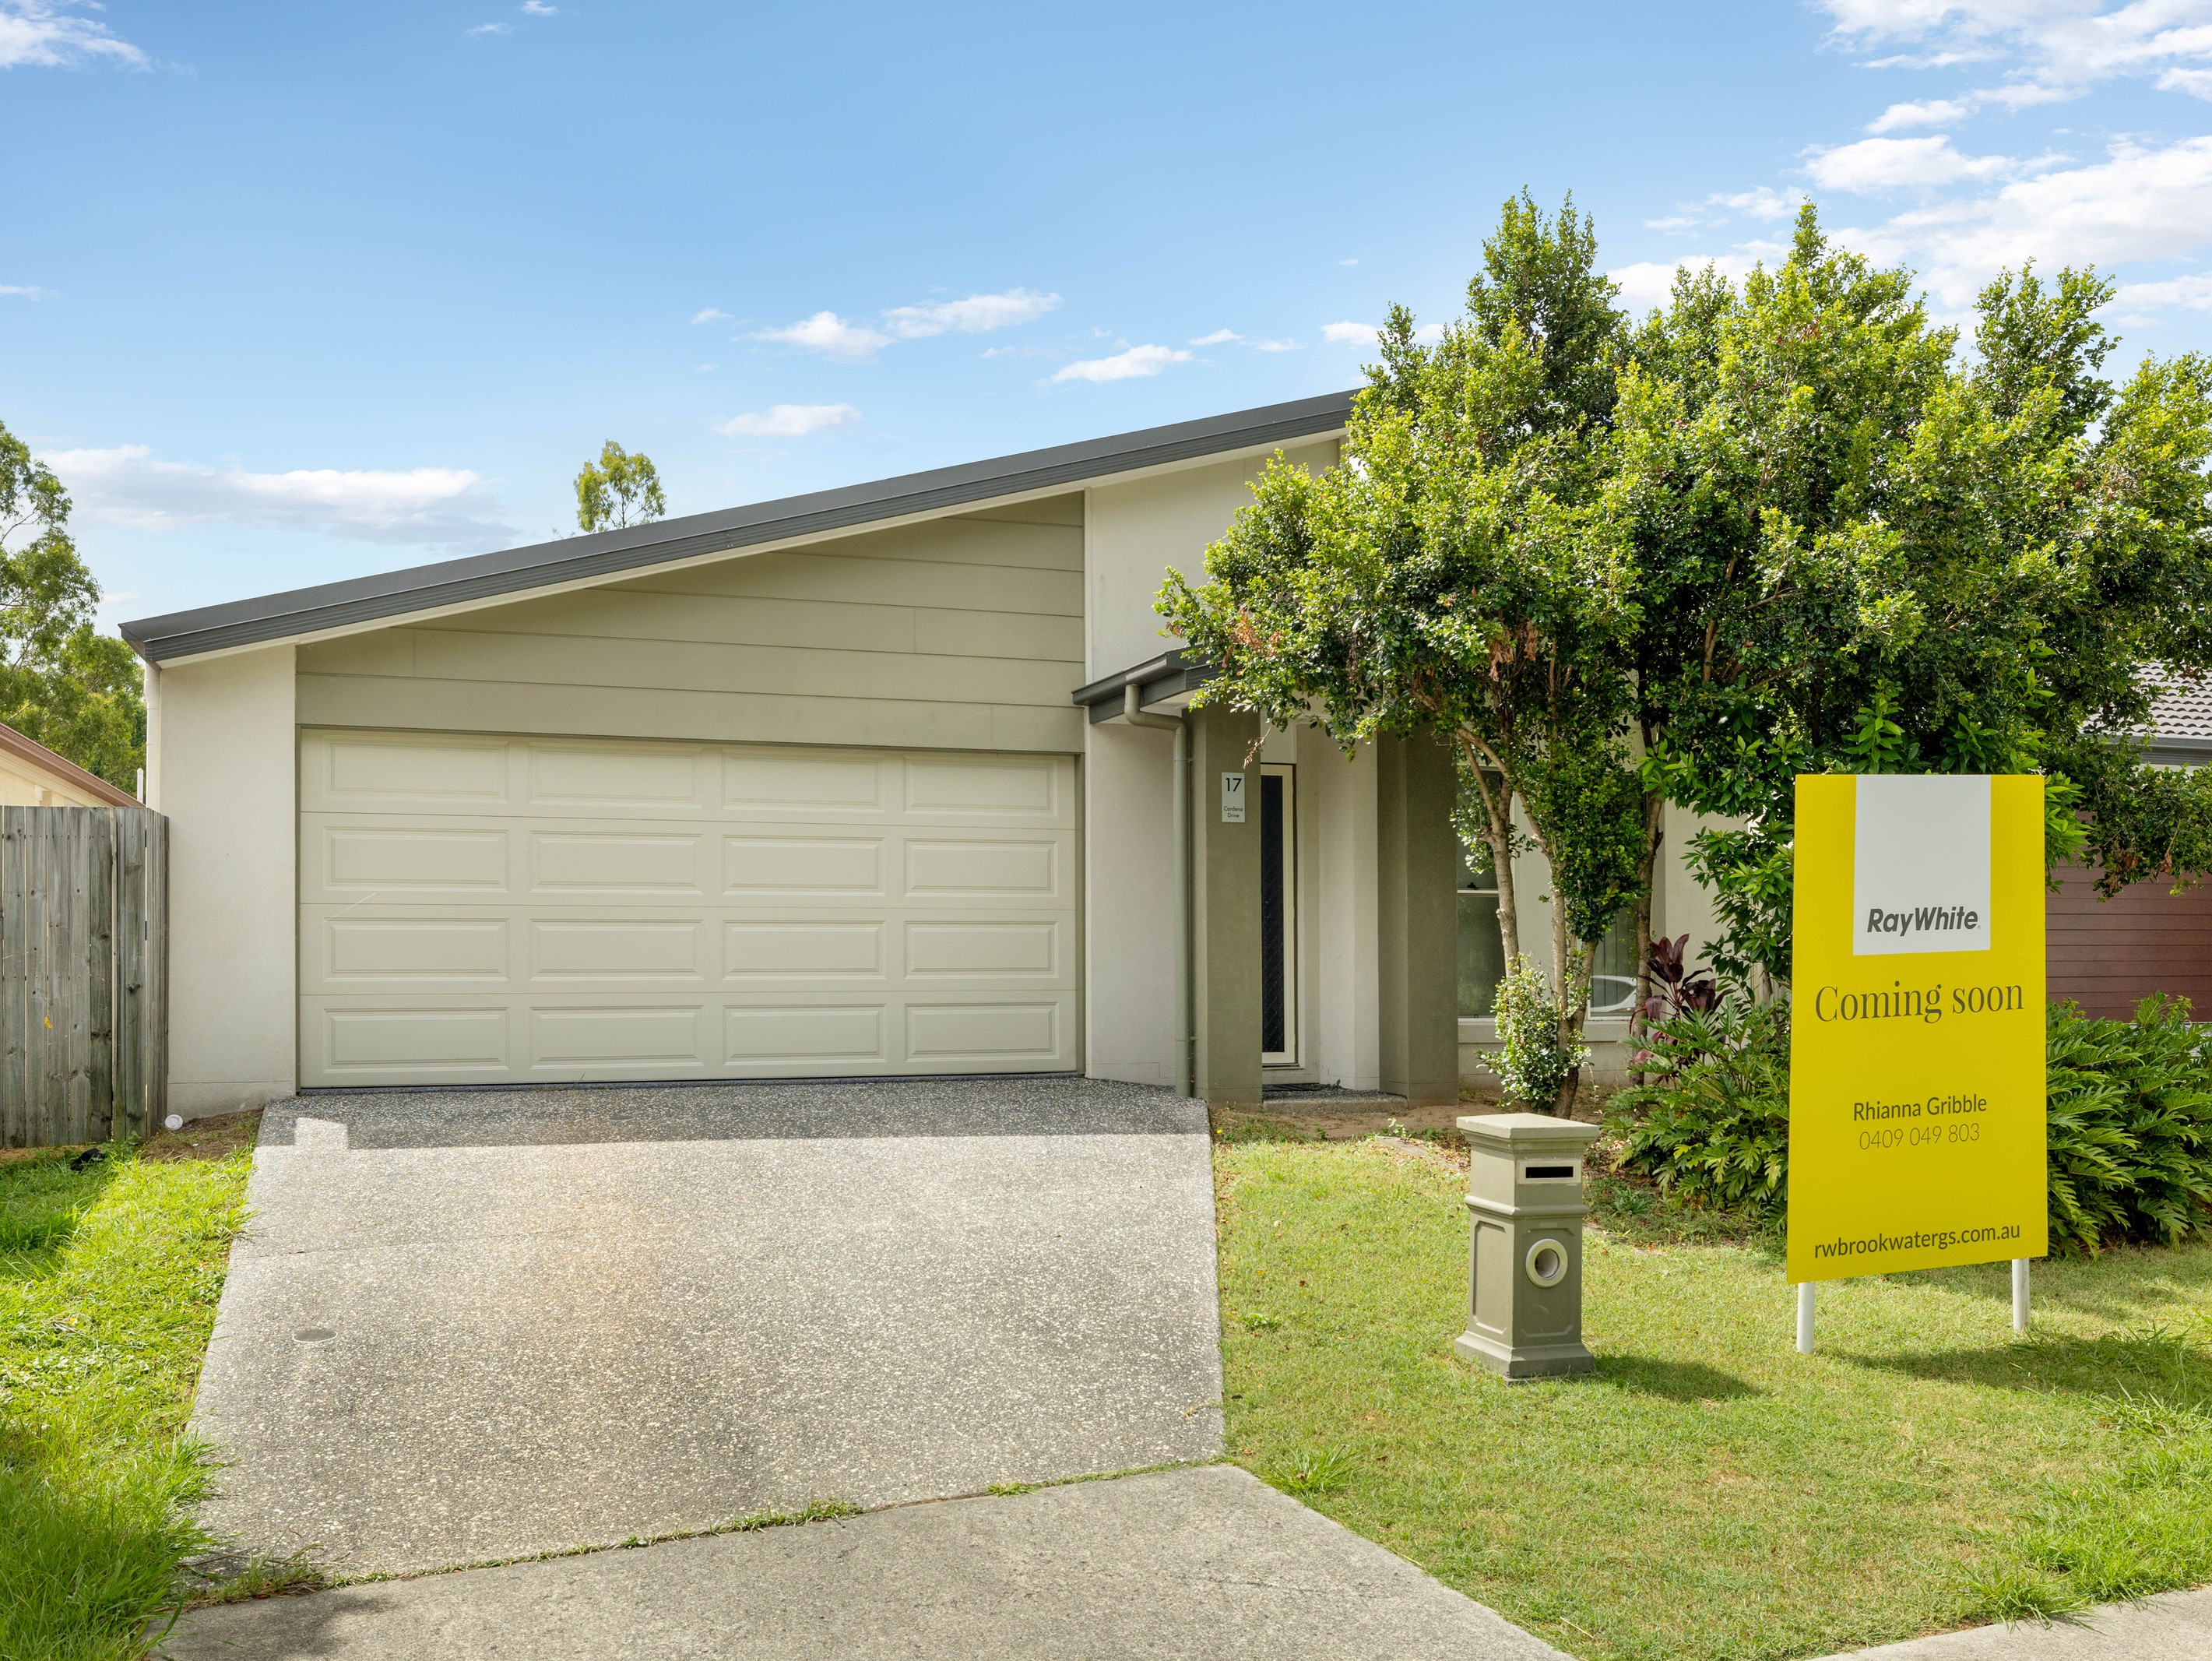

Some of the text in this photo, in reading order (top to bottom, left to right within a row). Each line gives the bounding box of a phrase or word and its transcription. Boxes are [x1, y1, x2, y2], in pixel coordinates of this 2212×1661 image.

[1226, 778, 1242, 792] 17
[1816, 980, 2024, 1023] Coming soon
[1853, 1094, 1987, 1122] Rhianna Gribble
[1859, 1123, 1980, 1149] 0409 049 803
[1814, 1224, 2021, 1259] rwbrookwatergs.com.au
